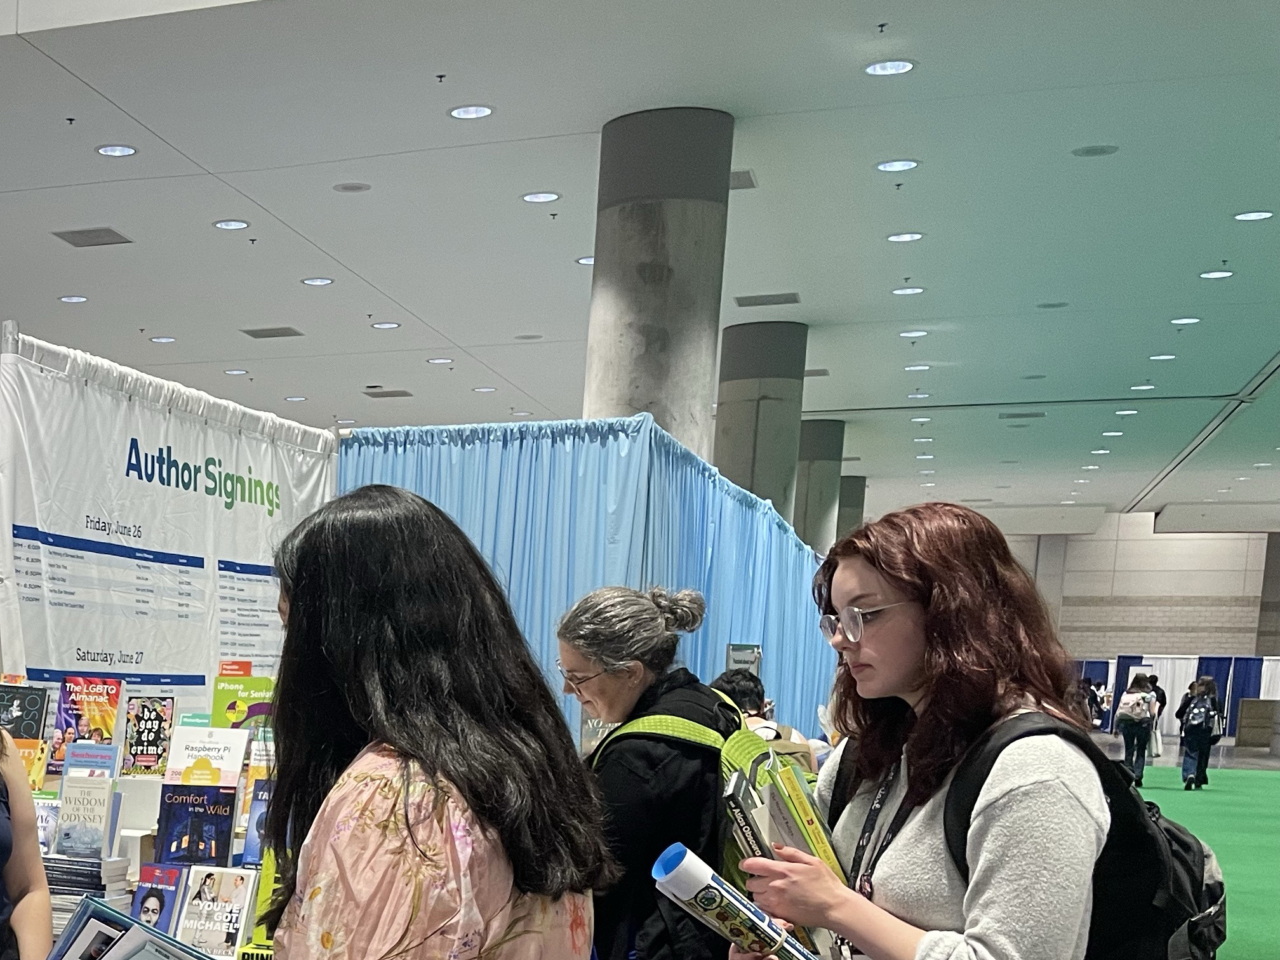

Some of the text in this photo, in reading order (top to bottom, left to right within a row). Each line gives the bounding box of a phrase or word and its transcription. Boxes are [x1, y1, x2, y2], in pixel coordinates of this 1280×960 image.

[125, 437, 280, 517] Author Signings
[85, 515, 142, 539] Friday, June 26
[76, 647, 143, 666] Saturday, June 27
[65, 683, 116, 694] The LGBTQ
[218, 682, 244, 690] iPhone
[69, 693, 109, 703] Almanac
[143, 708, 156, 719] be
[139, 720, 159, 731] gay
[141, 730, 154, 741] do
[131, 742, 164, 754] crime
[184, 745, 220, 753] Raspberry
[65, 797, 105, 807] WISDOM
[165, 793, 208, 804] Comfort
[206, 805, 230, 815] Wild
[61, 813, 105, 824] ODYSSEY
[742, 825, 762, 857] Obscura
[214, 913, 238, 923] GOT
